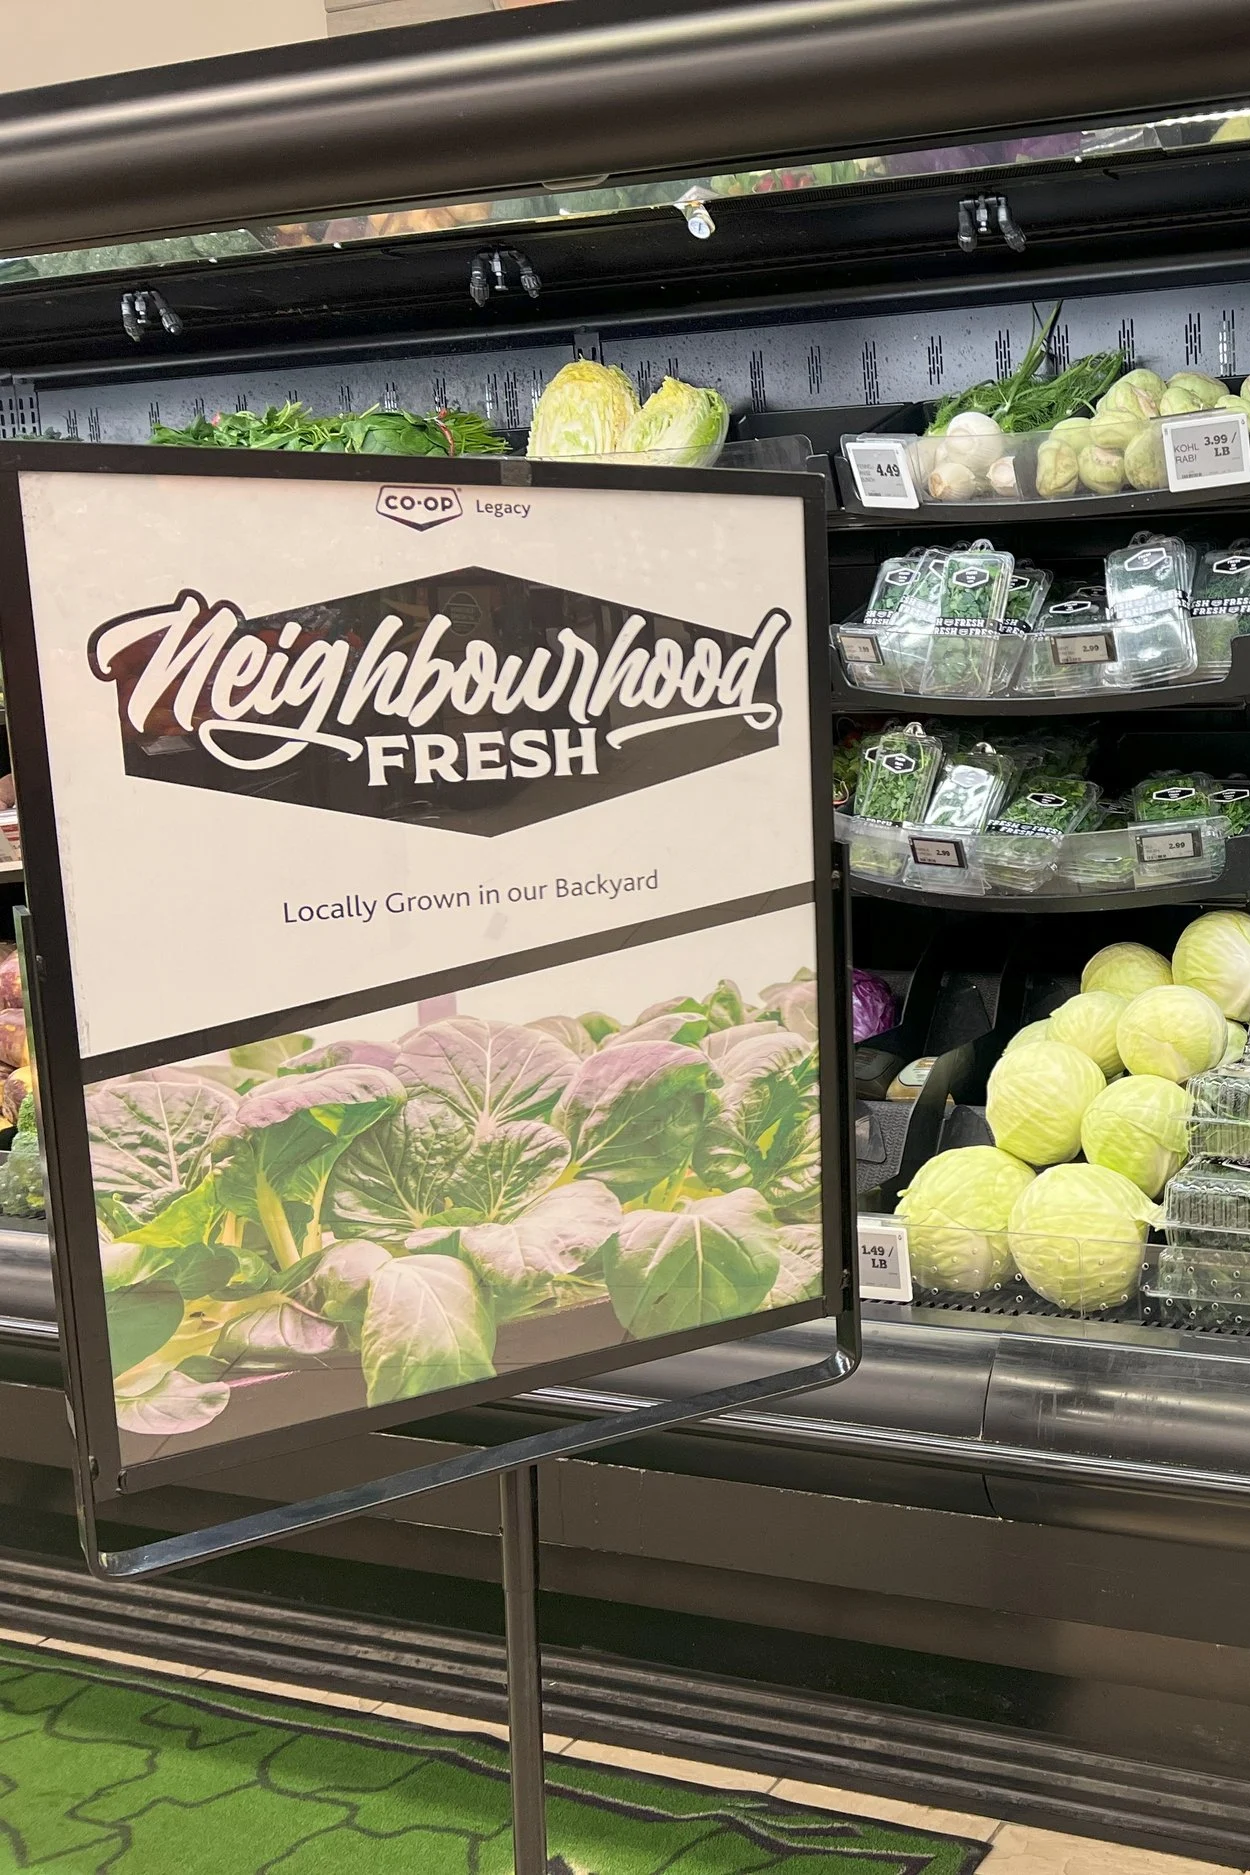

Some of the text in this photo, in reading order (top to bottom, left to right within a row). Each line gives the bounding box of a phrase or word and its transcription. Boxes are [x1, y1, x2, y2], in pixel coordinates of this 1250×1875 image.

[1204, 434, 1228, 446] 3.99
[1174, 443, 1199, 453] KOHL
[1214, 446, 1230, 457] LB
[1175, 455, 1197, 464] RABI
[877, 463, 900, 477] 4.49
[477, 500, 530, 518] Legacy
[1193, 607, 1226, 616] FRESH
[954, 618, 984, 627] FRESH
[96, 595, 786, 770] Neighbourhood
[366, 727, 600, 788] FRESH
[1168, 841, 1186, 849] 2.99
[283, 869, 659, 923] Locally Grown in our Backyard
[861, 1245, 884, 1256] 1.49
[872, 1258, 887, 1269] LB
